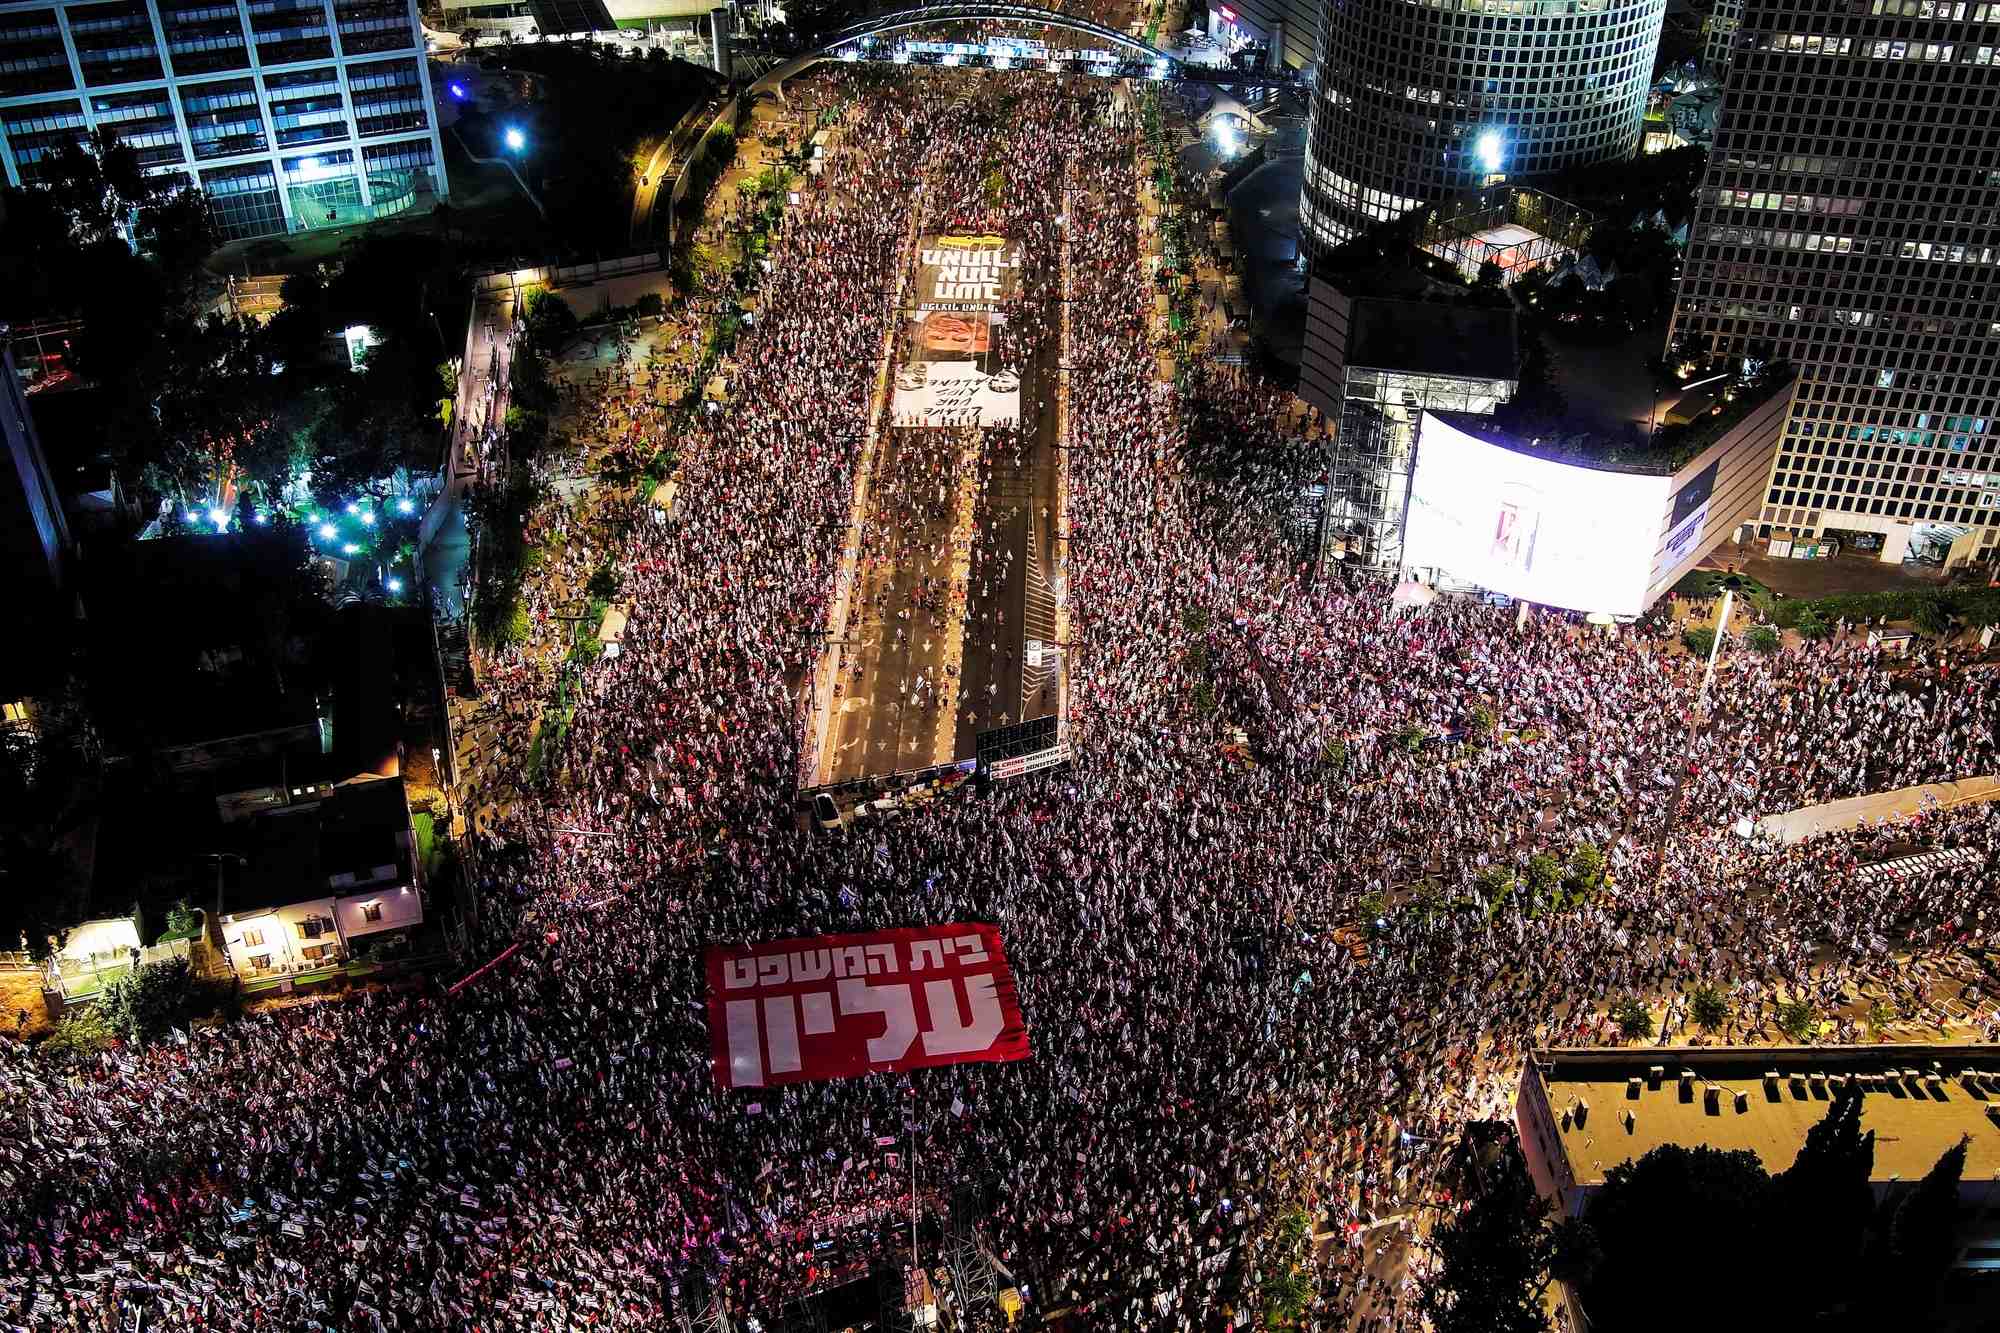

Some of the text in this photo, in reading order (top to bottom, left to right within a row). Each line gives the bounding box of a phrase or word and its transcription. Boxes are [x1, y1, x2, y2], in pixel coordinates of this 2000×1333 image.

[938, 266, 999, 283] אתה
[934, 282, 1001, 300] תשב
[928, 377, 989, 387] ALONE
[935, 387, 980, 397] KIDS
[935, 397, 972, 407] OUR
[923, 406, 983, 417] LEAVE
[1001, 757, 1024, 768] CRIME
[1001, 768, 1024, 777] CRIME
[723, 934, 990, 990] בית המשפט
[725, 973, 1005, 1088] עליון
